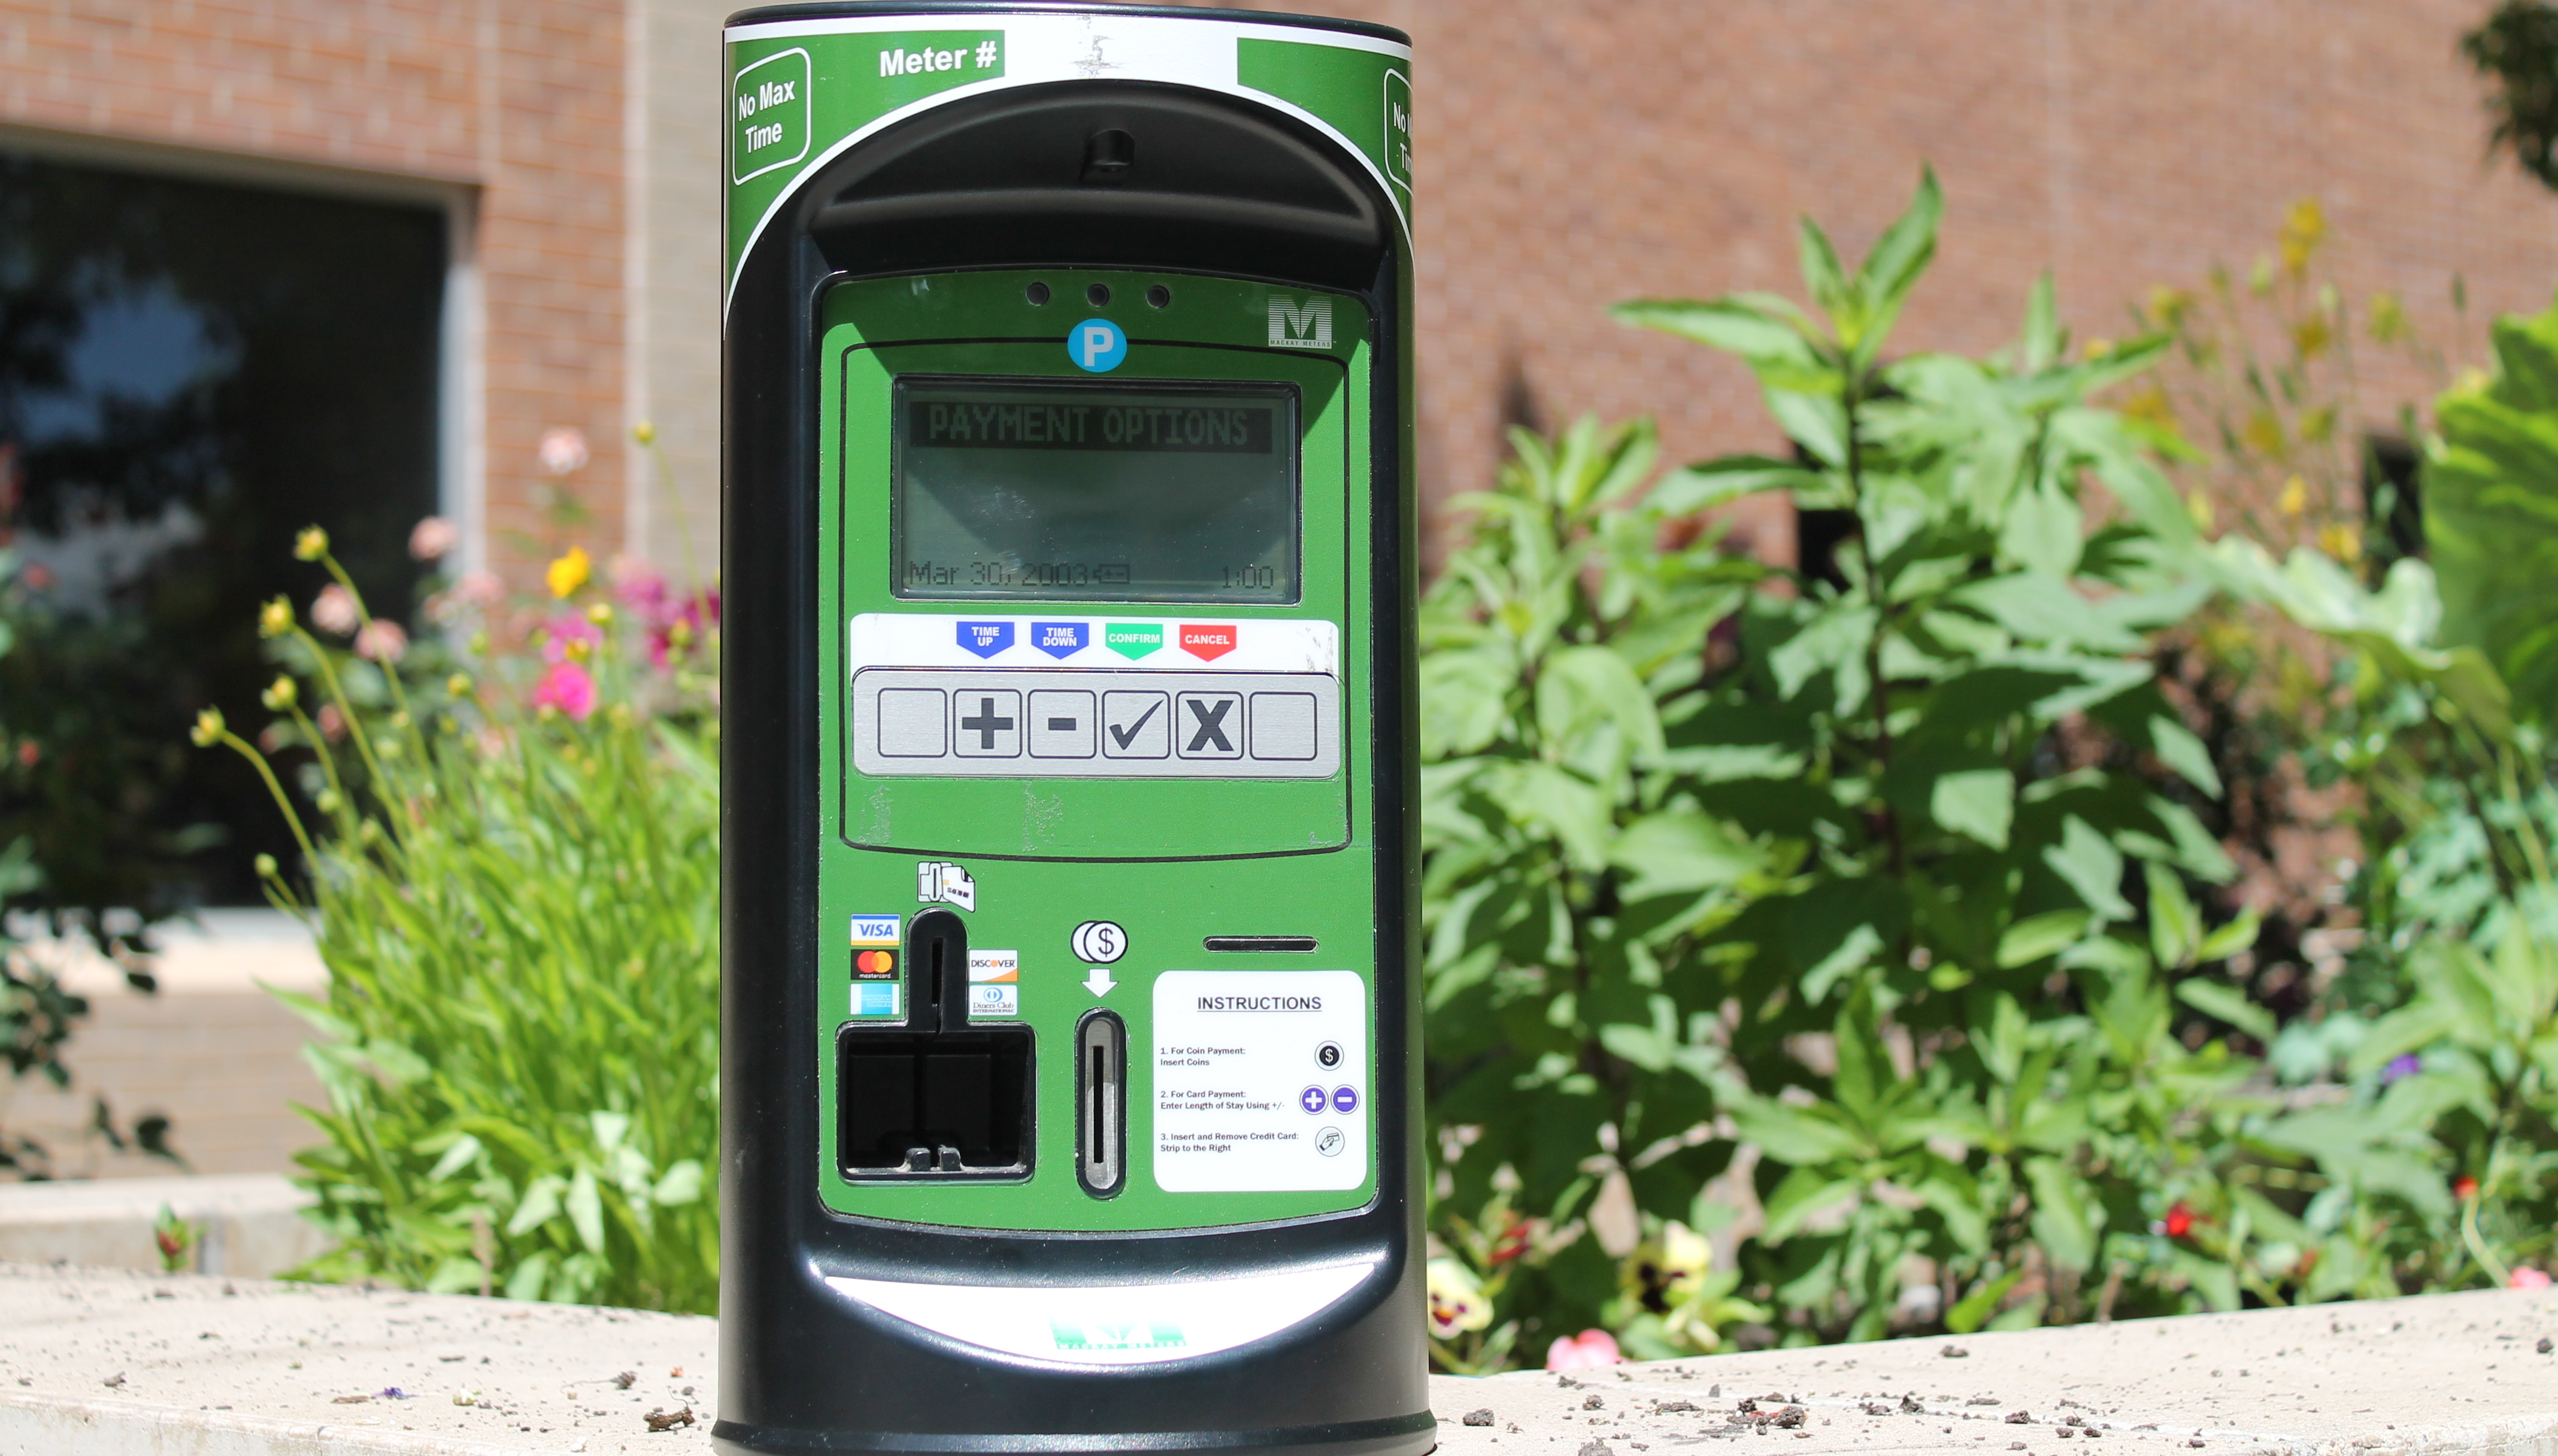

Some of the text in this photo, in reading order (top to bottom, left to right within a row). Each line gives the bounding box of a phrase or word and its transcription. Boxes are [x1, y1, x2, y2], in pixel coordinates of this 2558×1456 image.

[880, 41, 996, 77] Meter #
[738, 80, 796, 122] No Max
[1393, 101, 1406, 133] No
[745, 122, 783, 153] Time
[1400, 142, 1412, 175] Tim
[929, 404, 1248, 445] PAYMENT OPTIONS
[910, 560, 1088, 587] Mar 30, 2003
[1223, 565, 1274, 589] 1:00
[971, 627, 1000, 638] TIME
[1046, 628, 1074, 638] TIME
[977, 636, 993, 647] UP
[1042, 637, 1077, 648] DOWN
[1108, 633, 1160, 644] CONFIRM
[1184, 635, 1229, 645] CANCEL
[857, 924, 894, 936] VISA
[971, 959, 1016, 967] DISCOVER
[1198, 997, 1322, 1010] INSTRUCTIONS
[1208, 1047, 1246, 1056] Payment:
[1208, 1091, 1246, 1099] Payment:
[1185, 1102, 1213, 1111] Length
[1226, 1102, 1244, 1111] Stay
[1247, 1102, 1269, 1111] Using
[1160, 1145, 1180, 1153] Strip
[1210, 1145, 1231, 1153] Right
